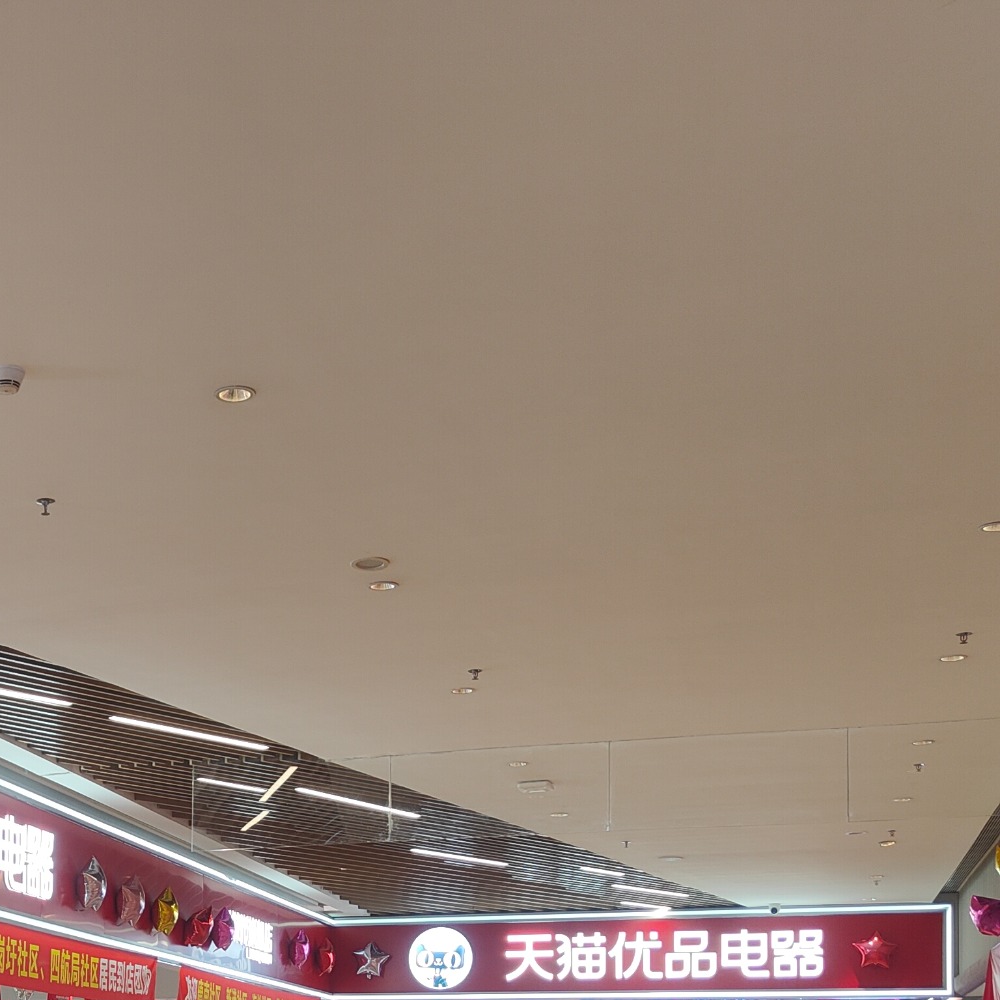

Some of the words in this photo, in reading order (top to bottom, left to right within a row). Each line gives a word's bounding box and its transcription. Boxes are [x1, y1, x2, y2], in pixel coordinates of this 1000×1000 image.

[504, 929, 824, 981] 天猫优品电器
